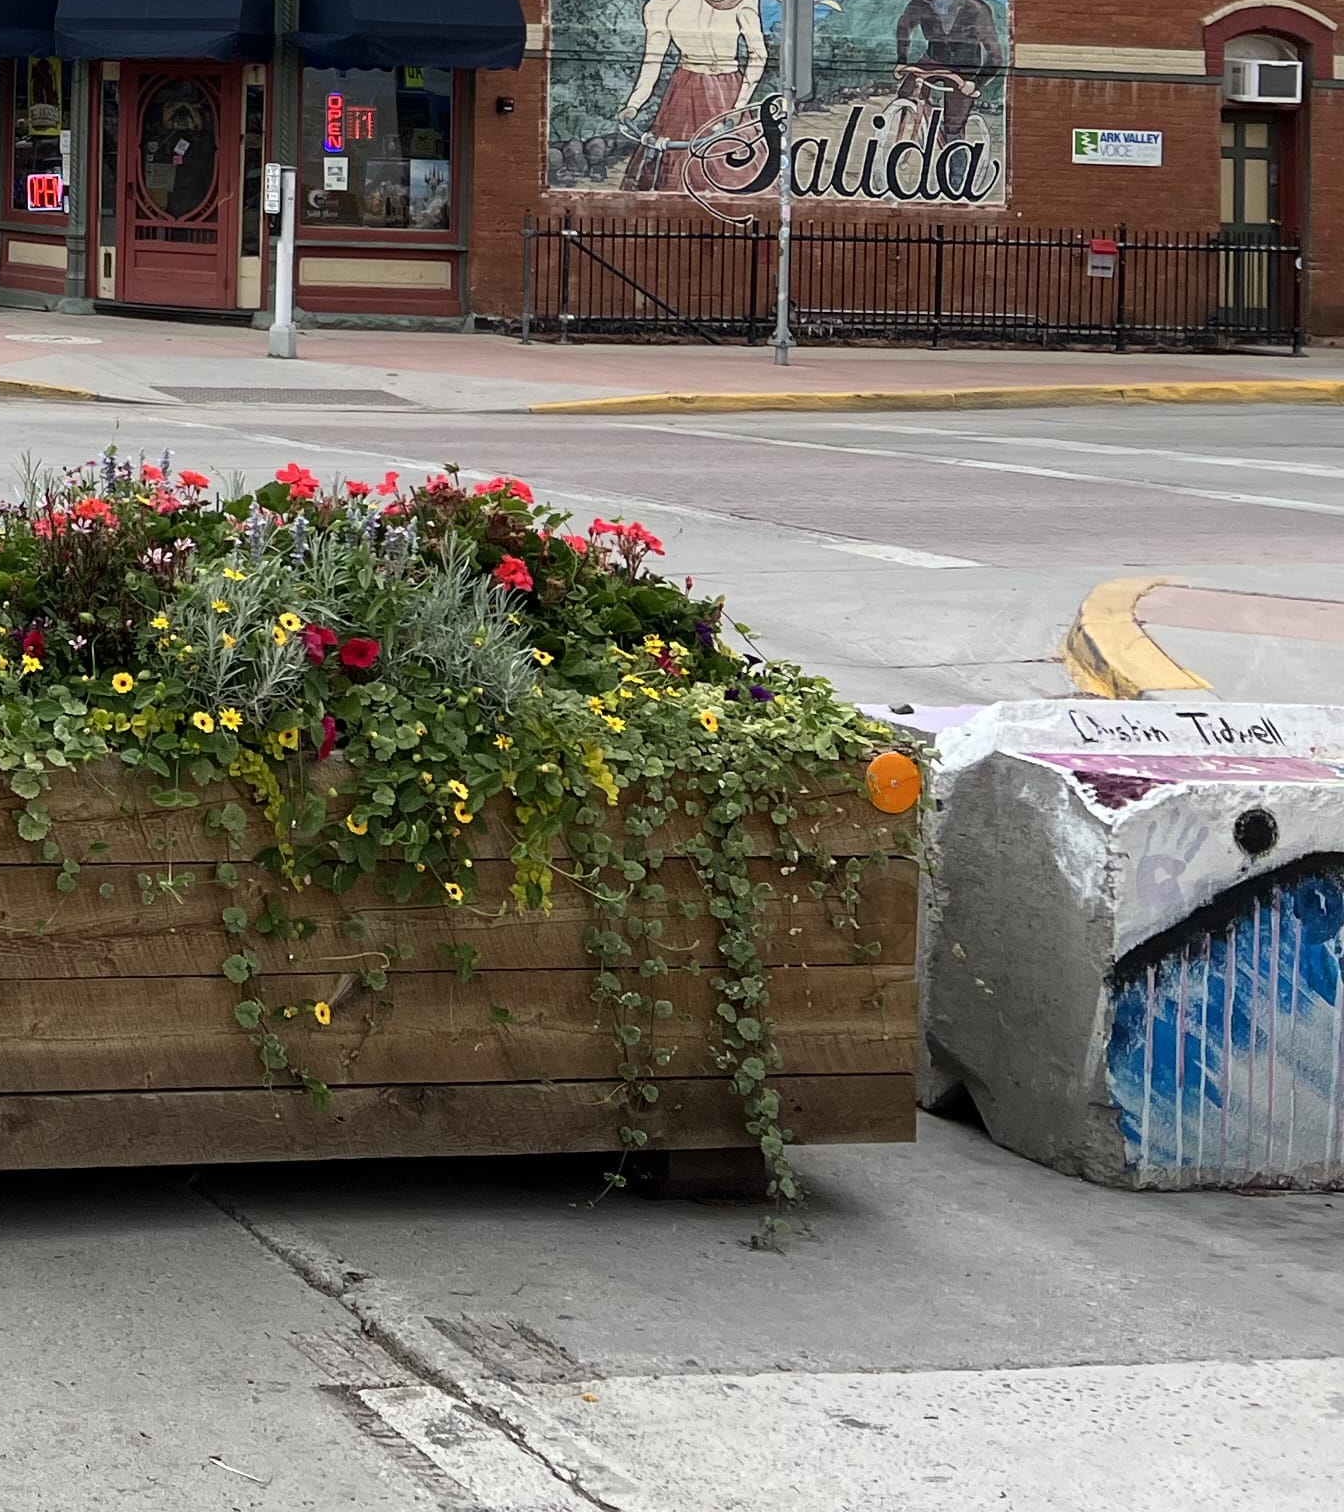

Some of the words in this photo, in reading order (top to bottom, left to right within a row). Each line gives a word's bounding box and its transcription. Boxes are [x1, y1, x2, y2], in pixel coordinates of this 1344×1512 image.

[327, 95, 343, 149] OPEN
[1100, 132, 1122, 143] ARK
[1122, 133, 1161, 144] VALLEY
[684, 94, 1000, 226] Salida
[1100, 144, 1133, 158] VOICE
[29, 176, 60, 208] OPEN
[1175, 712, 1286, 747] Tidwell
